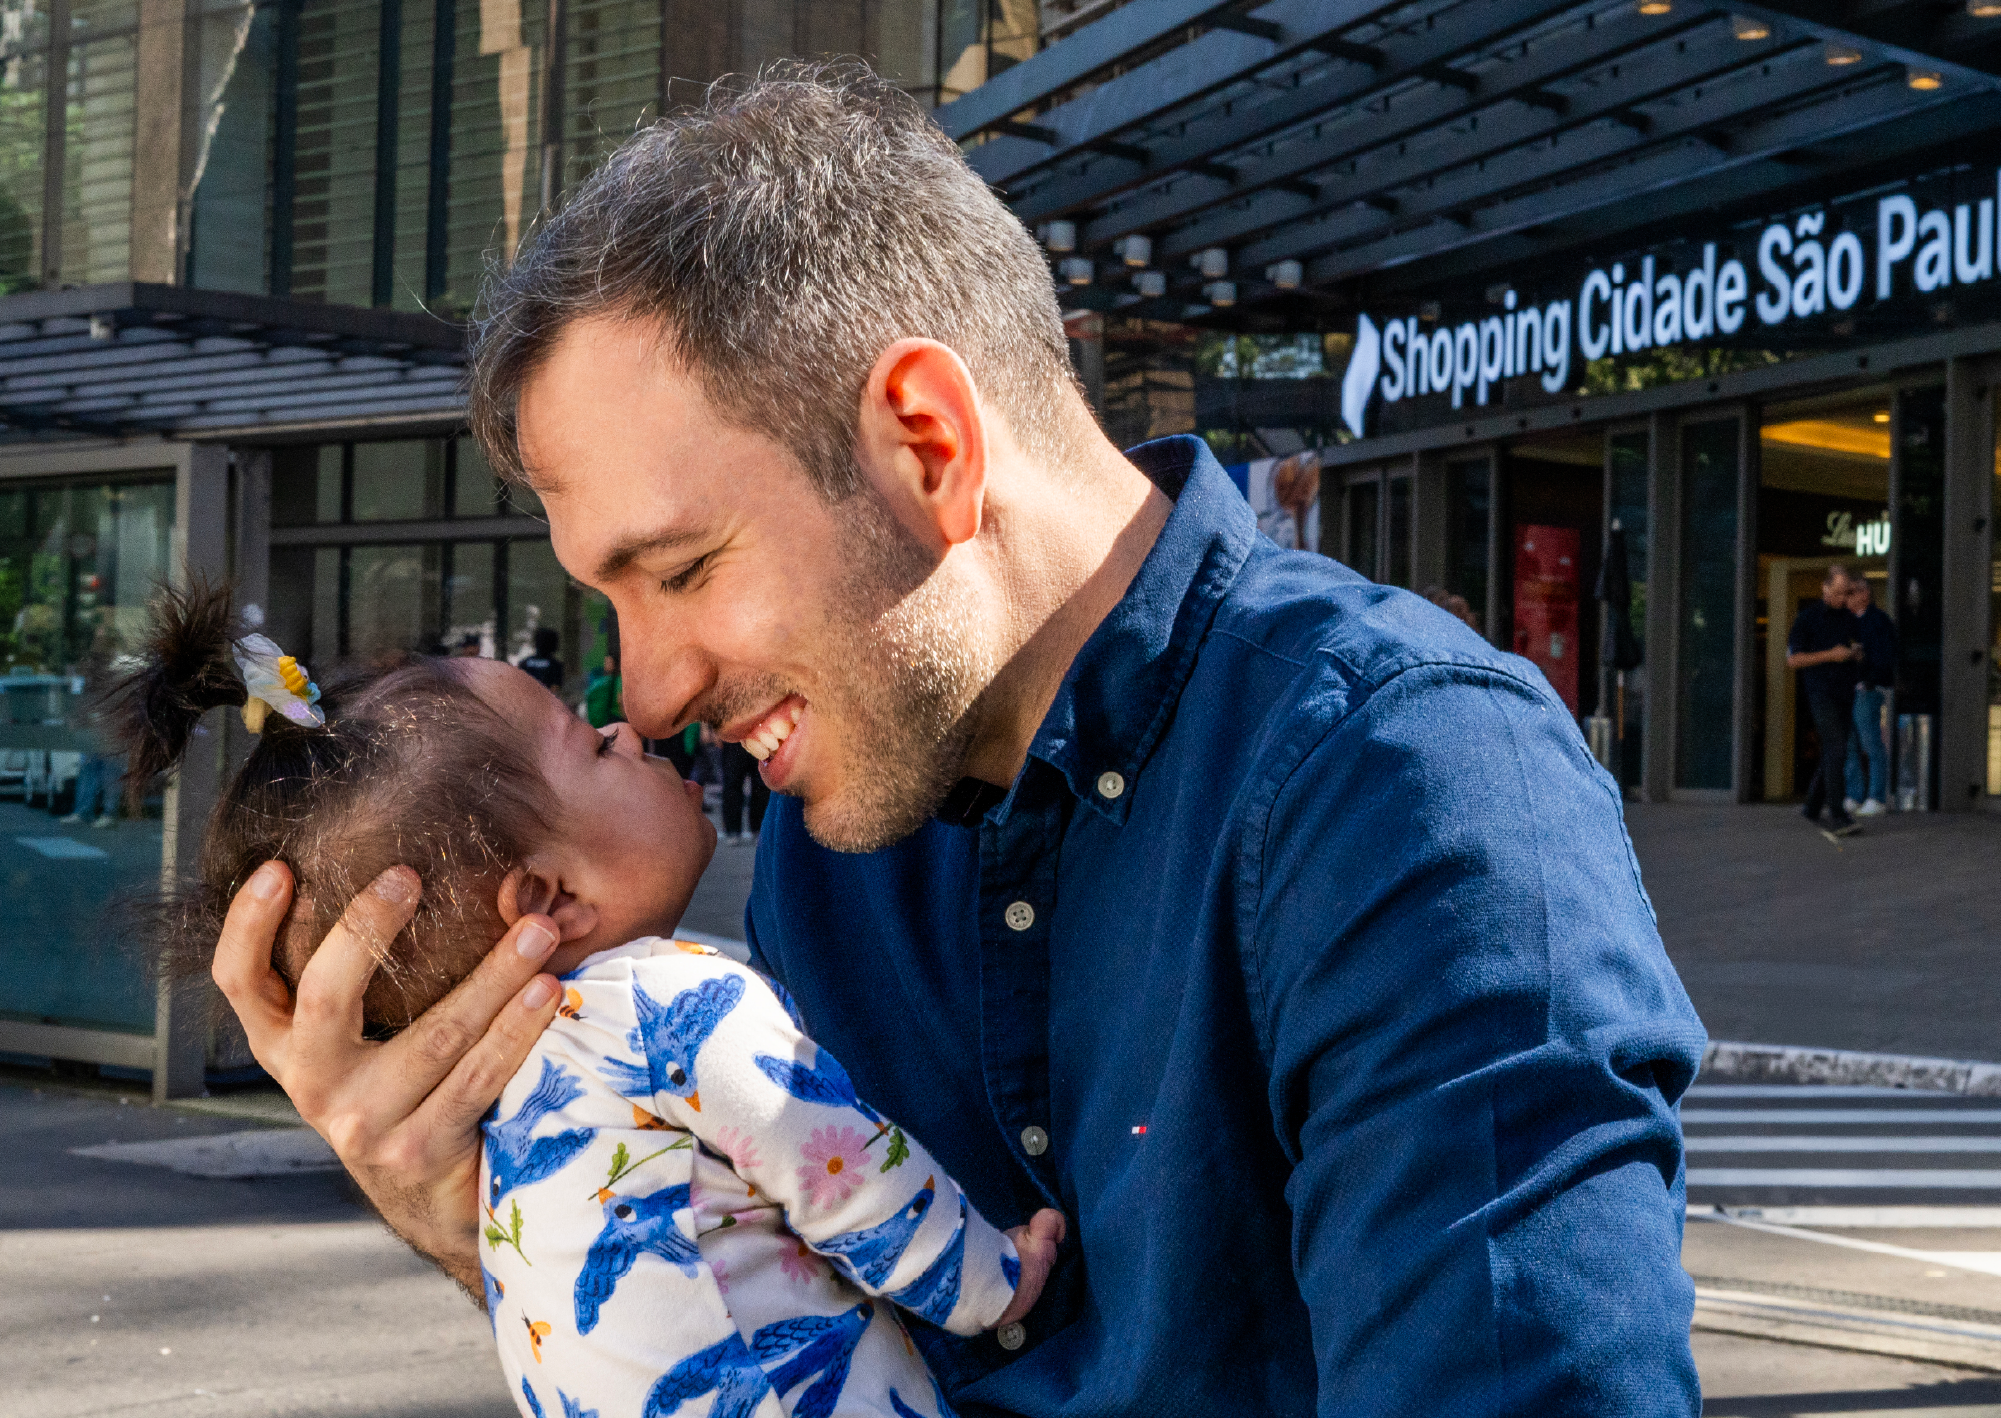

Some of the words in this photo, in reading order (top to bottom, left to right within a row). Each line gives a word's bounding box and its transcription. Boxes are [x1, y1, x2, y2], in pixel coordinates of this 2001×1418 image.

[1381, 289, 1571, 409] Shopping
[1579, 243, 1747, 361] Cidade
[1756, 211, 1864, 325] São
